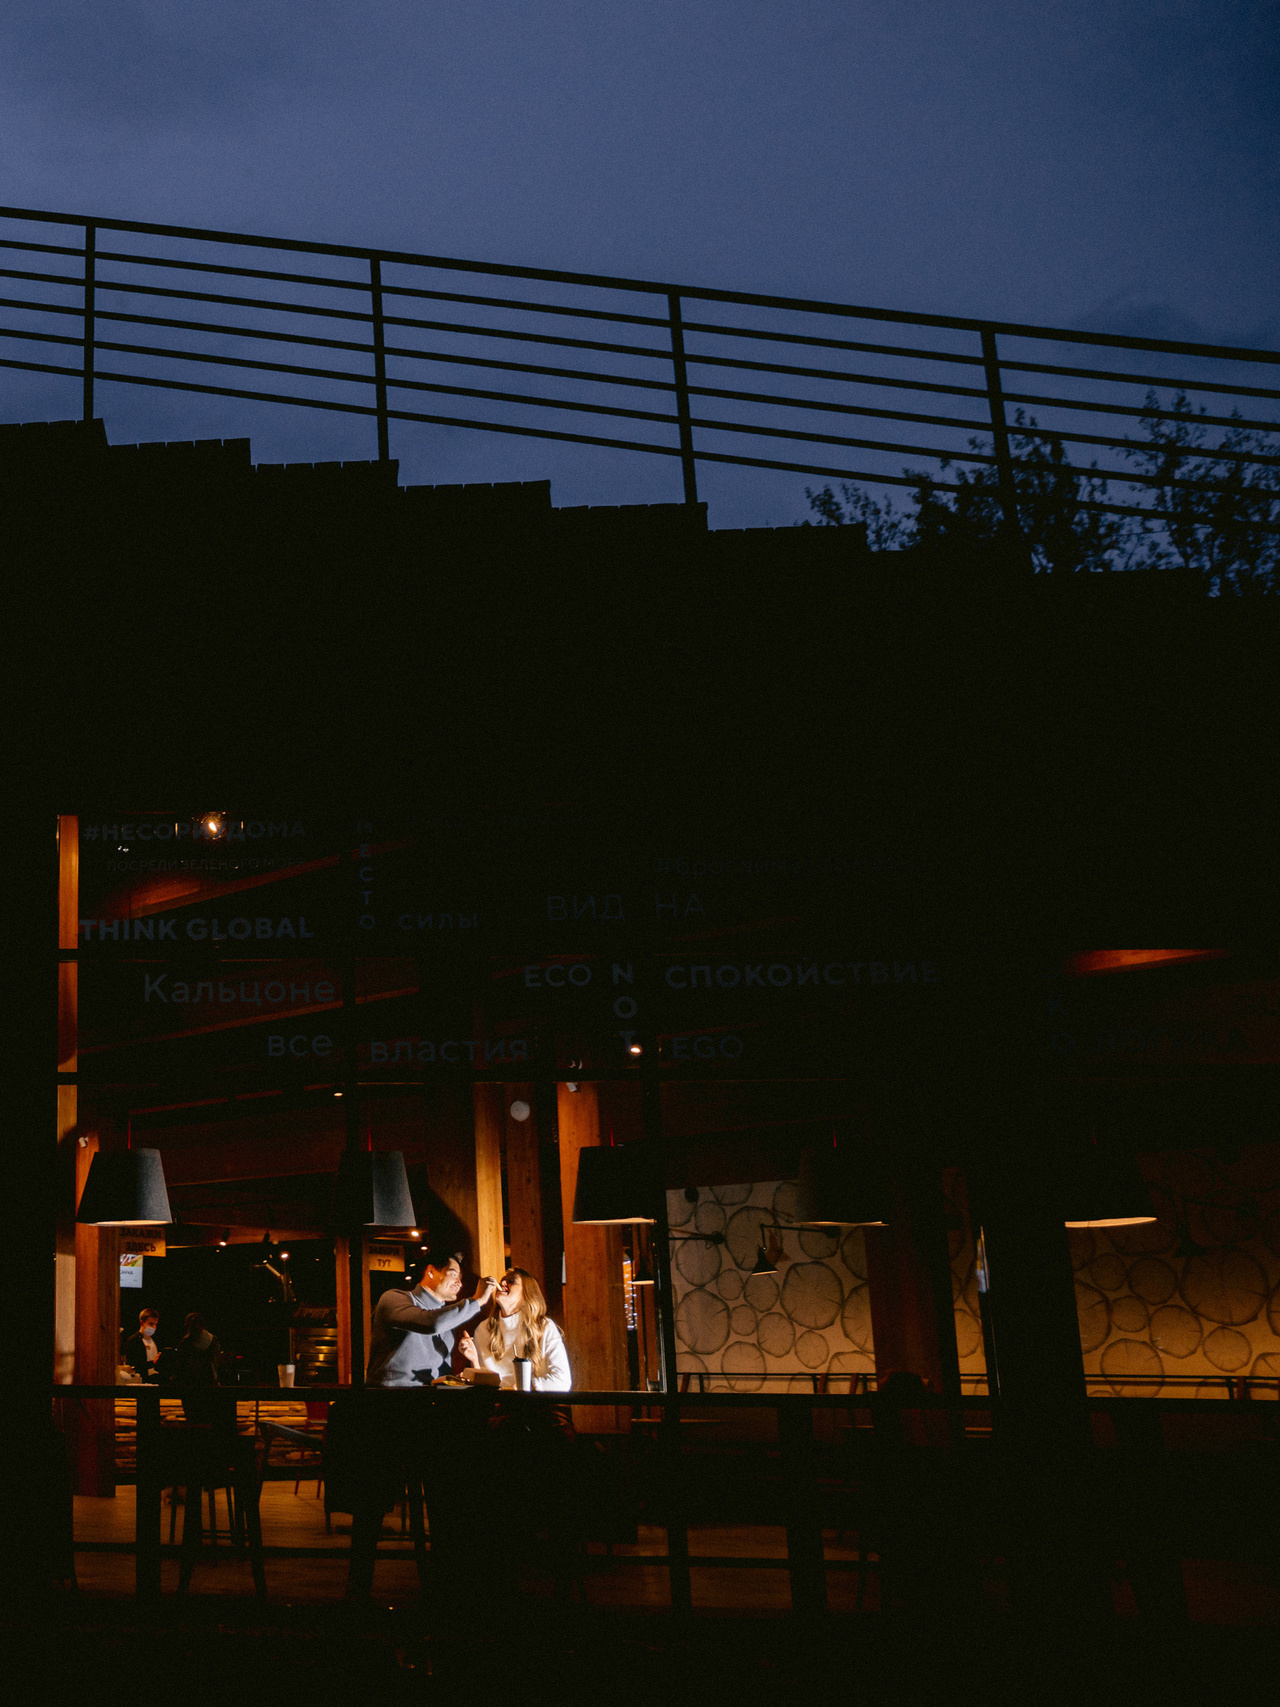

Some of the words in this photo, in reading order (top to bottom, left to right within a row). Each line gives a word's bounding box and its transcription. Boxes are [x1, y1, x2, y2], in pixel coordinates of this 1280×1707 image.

[545, 892, 627, 925] ВИД
[653, 890, 708, 919] НА
[79, 918, 178, 942] THINK
[185, 917, 315, 941] GLOBAL
[522, 963, 595, 989] ECO
[663, 956, 942, 990] СПОКОЙСТВИЕ
[143, 972, 337, 1007] Кальцоне
[266, 1032, 334, 1057] все
[370, 1037, 530, 1063] властия
[670, 1035, 745, 1061] EGO
[126, 1242, 156, 1253] ЗДЕСЬ
